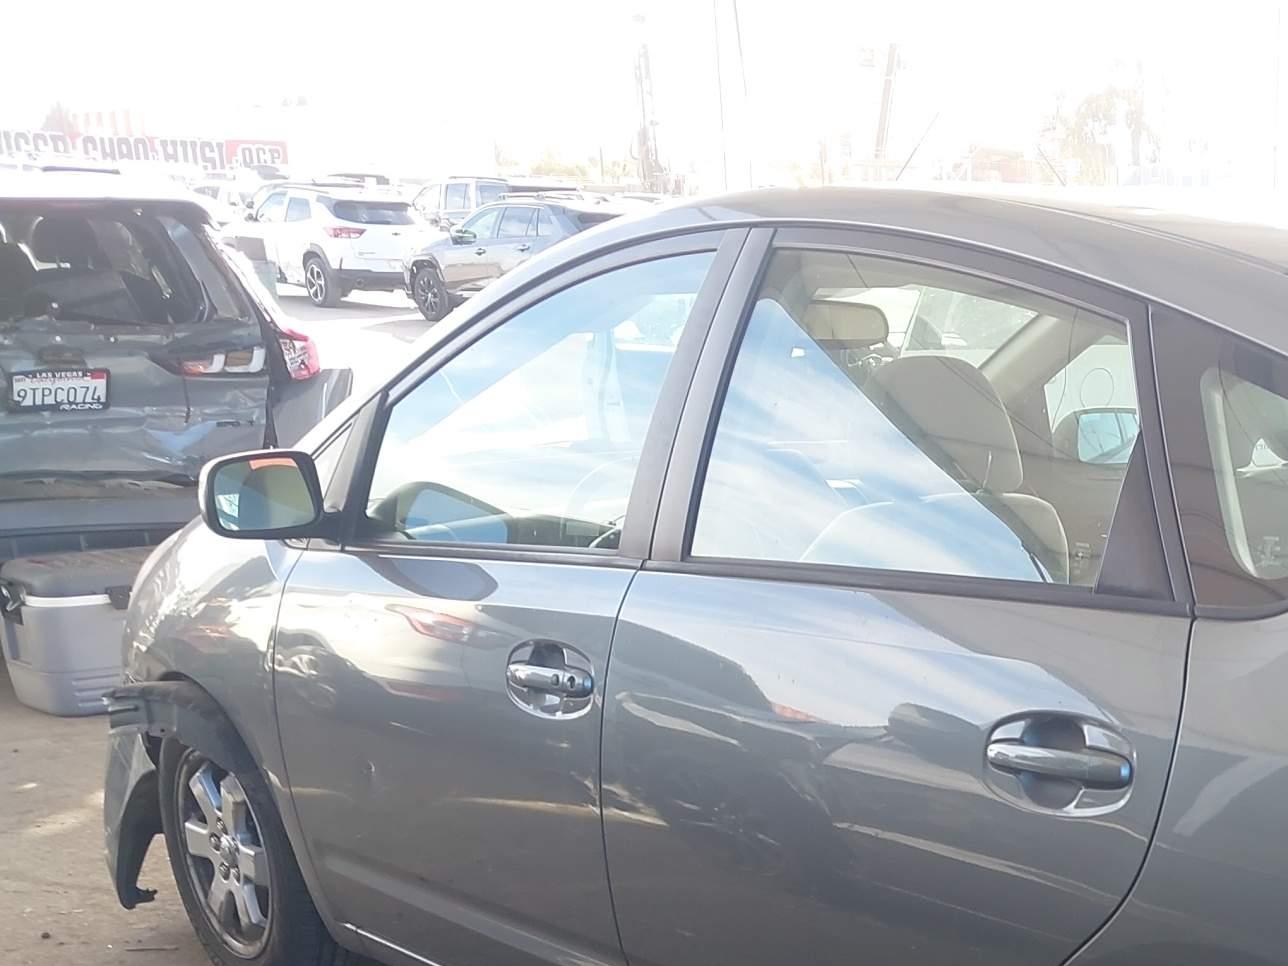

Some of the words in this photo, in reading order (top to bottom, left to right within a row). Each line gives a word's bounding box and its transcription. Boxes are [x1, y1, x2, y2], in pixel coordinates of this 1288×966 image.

[54, 370, 83, 378] VEGAS
[17, 386, 101, 406] 9TPC074
[60, 403, 103, 411] RACING
